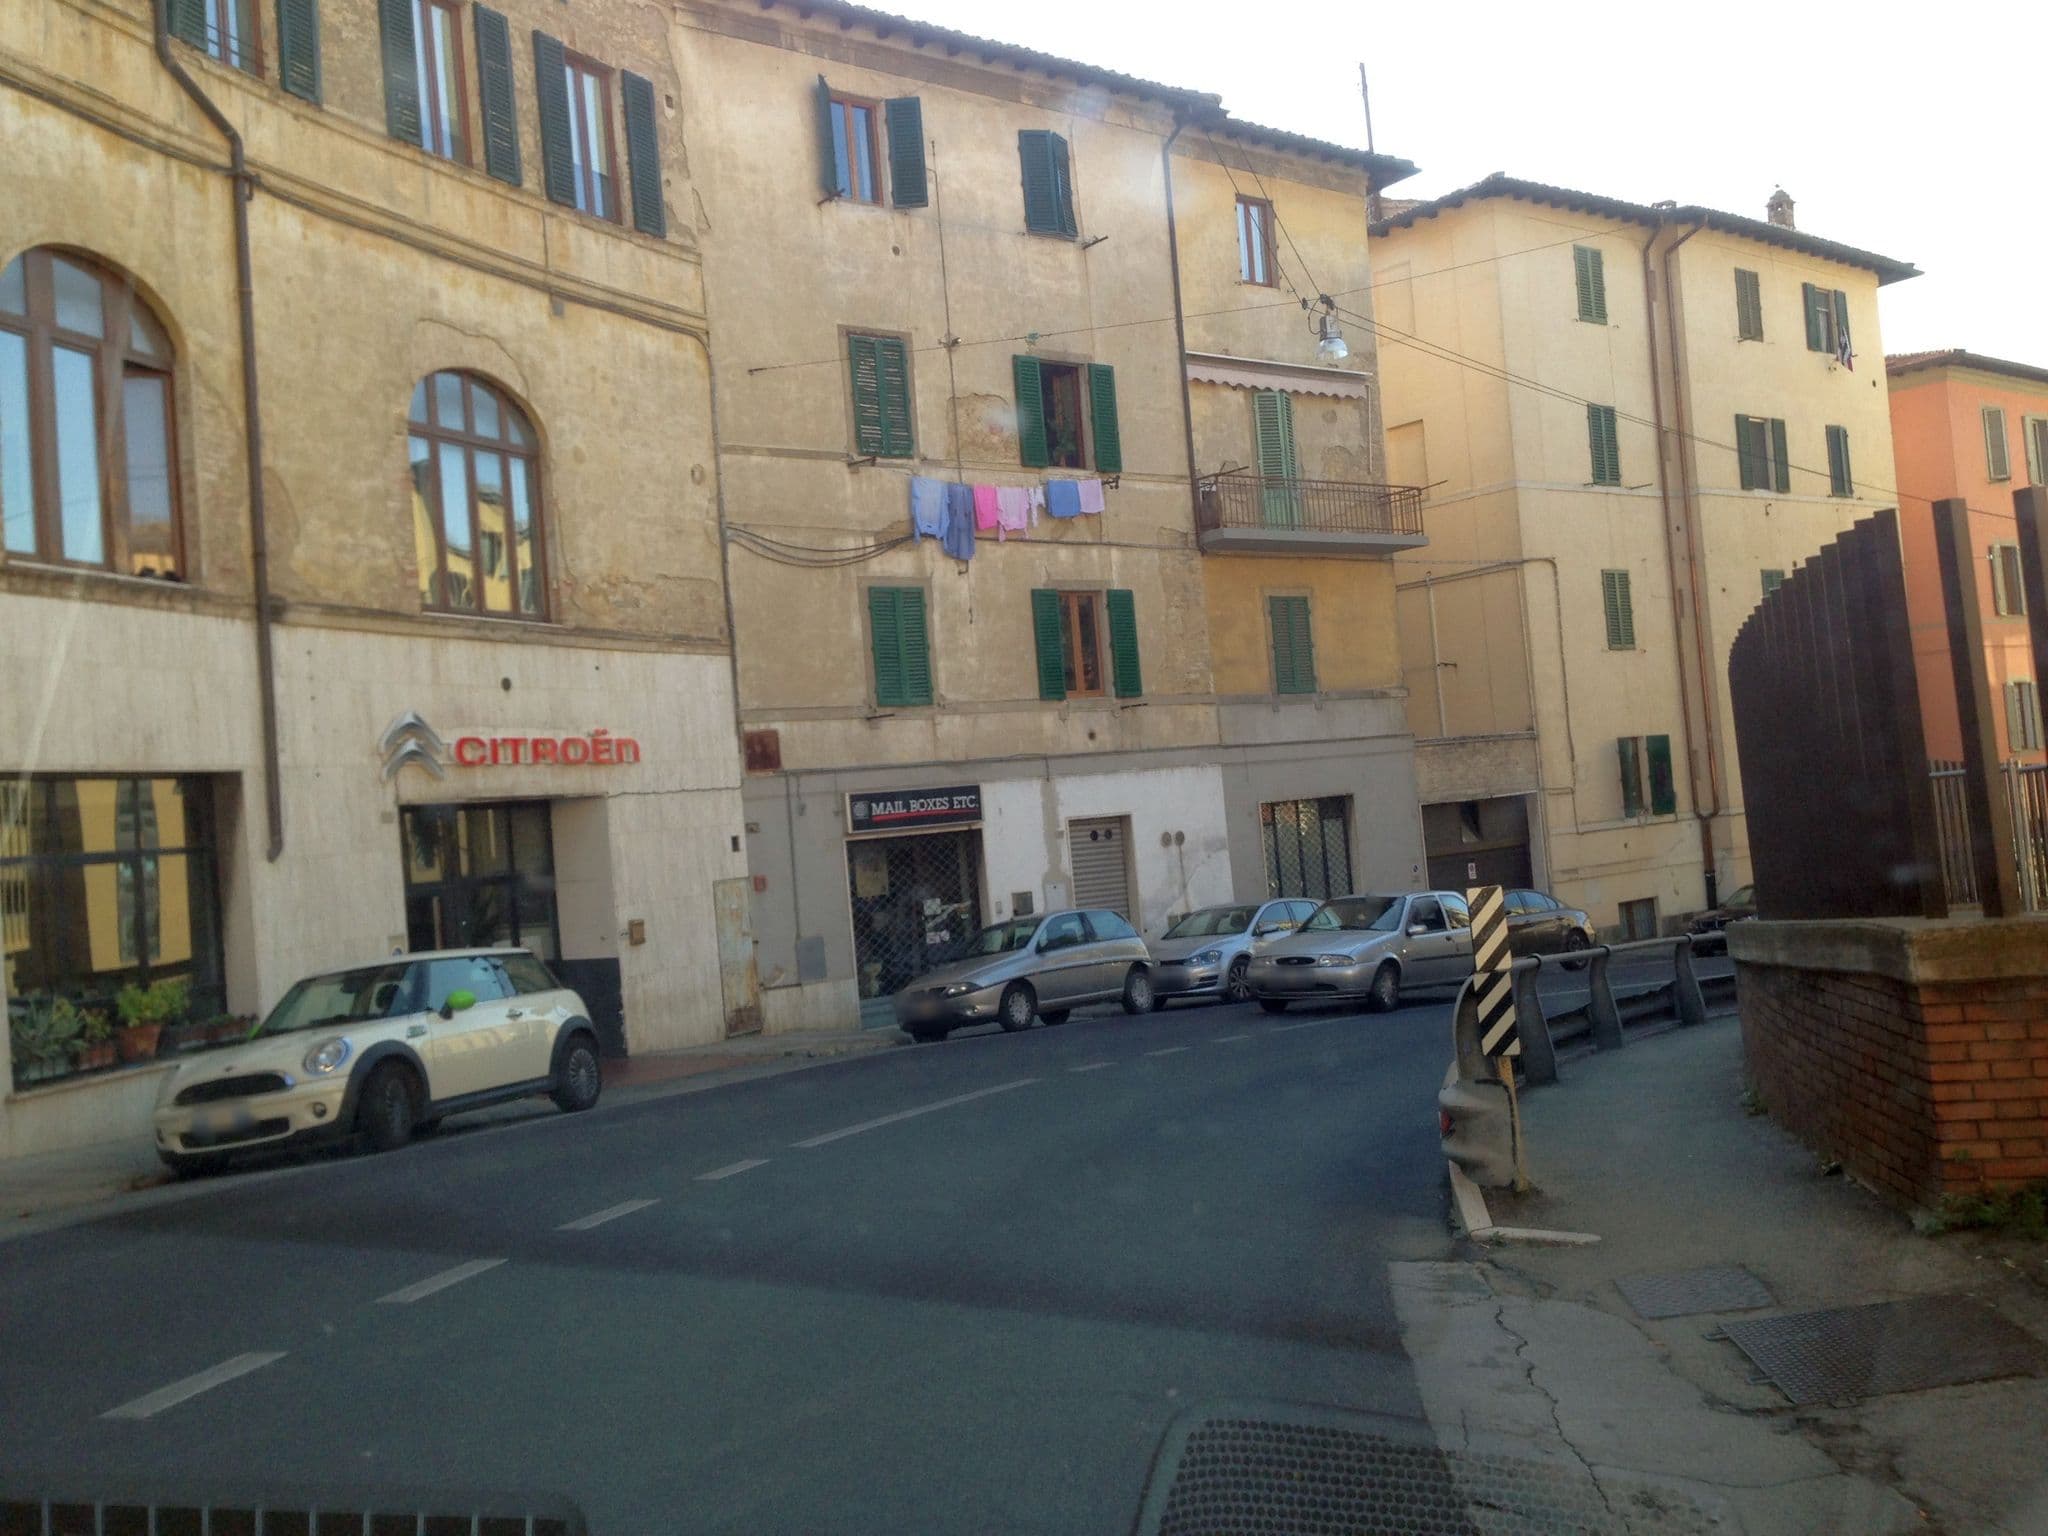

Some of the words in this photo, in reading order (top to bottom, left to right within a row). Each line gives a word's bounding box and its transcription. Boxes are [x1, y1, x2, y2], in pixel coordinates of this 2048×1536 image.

[871, 801, 906, 815] MAIL
[909, 797, 949, 812] BOXES
[952, 796, 979, 808] ETC.
